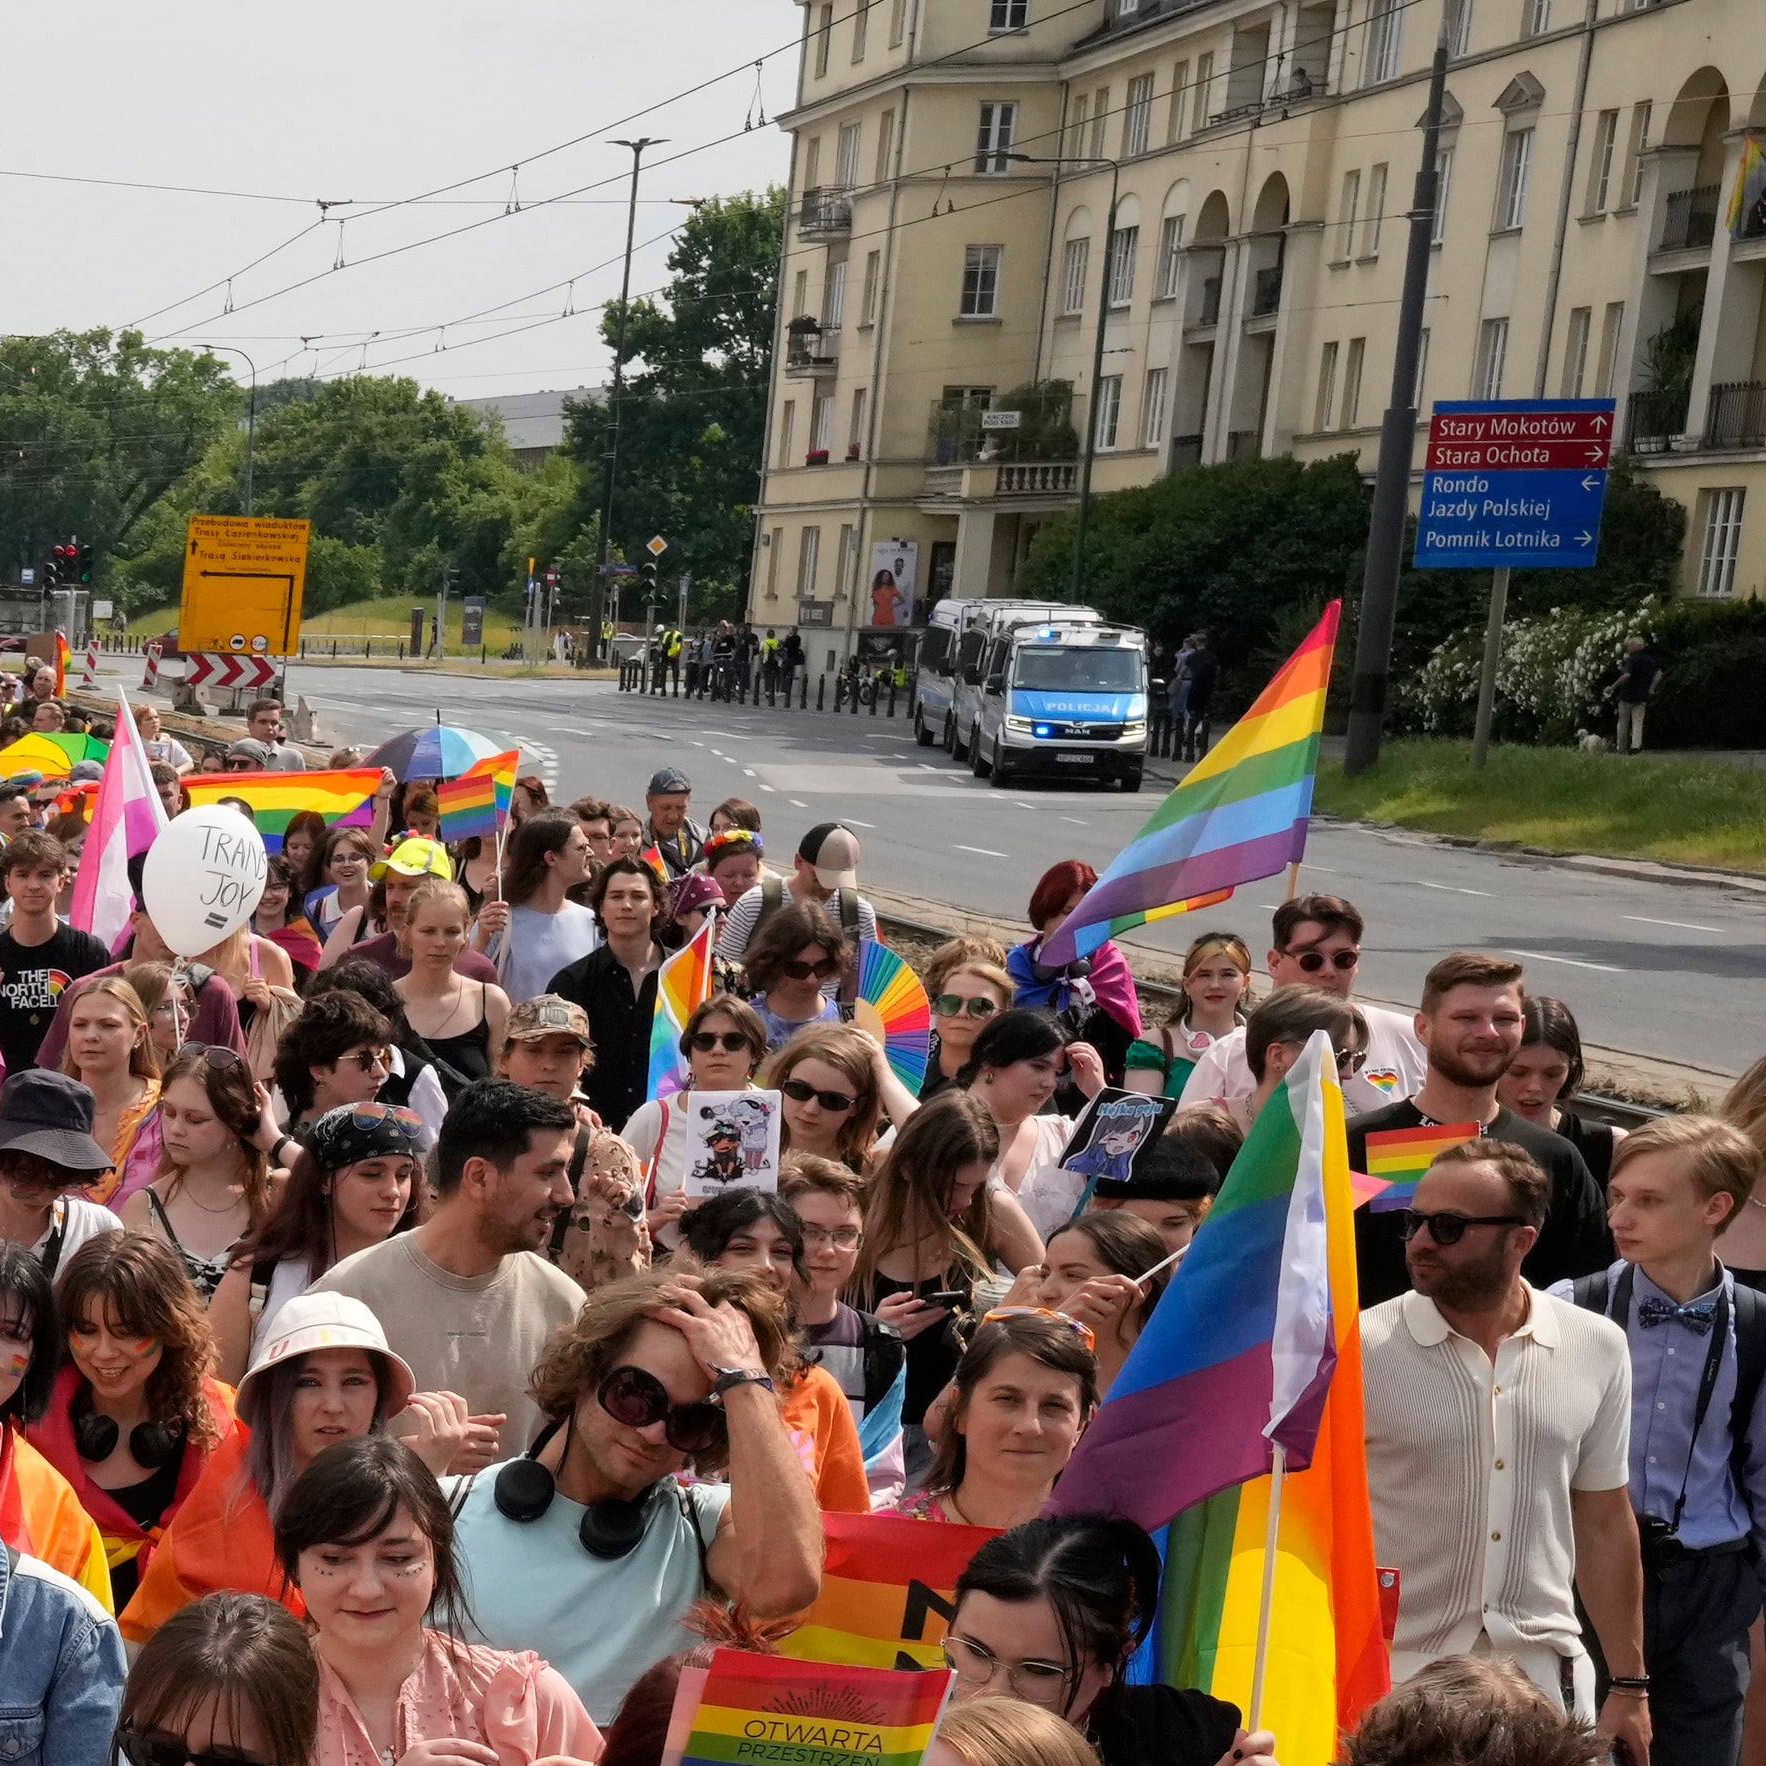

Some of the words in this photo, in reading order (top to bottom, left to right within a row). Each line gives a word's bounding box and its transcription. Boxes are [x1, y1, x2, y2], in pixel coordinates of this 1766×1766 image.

[1438, 420, 1487, 440] Stary
[1489, 418, 1576, 437] Mokotów
[1435, 448, 1479, 465] Stara
[1484, 446, 1550, 464] Ochota
[1432, 476, 1489, 494] Rondo
[1428, 500, 1477, 520] Jazdy
[1482, 499, 1551, 520] Polskiej
[191, 516, 249, 529] Przebudowa
[195, 528, 220, 539] Trasy
[225, 529, 300, 543] Łazienkowskiej
[1426, 530, 1490, 548] Pomnik
[1494, 530, 1561, 548] Lotnika
[232, 552, 301, 564] Siekierkowska
[1046, 702, 1112, 713] POLICJA
[1064, 728, 1091, 736] MAN
[195, 824, 268, 881] TRANS
[200, 870, 257, 915] JOY
[17, 968, 48, 983] THE
[10, 995, 48, 1010] FACE
[1095, 1102, 1133, 1119] Hejka
[1133, 1100, 1163, 1118] geju
[743, 1719, 883, 1753] OTWARTA
